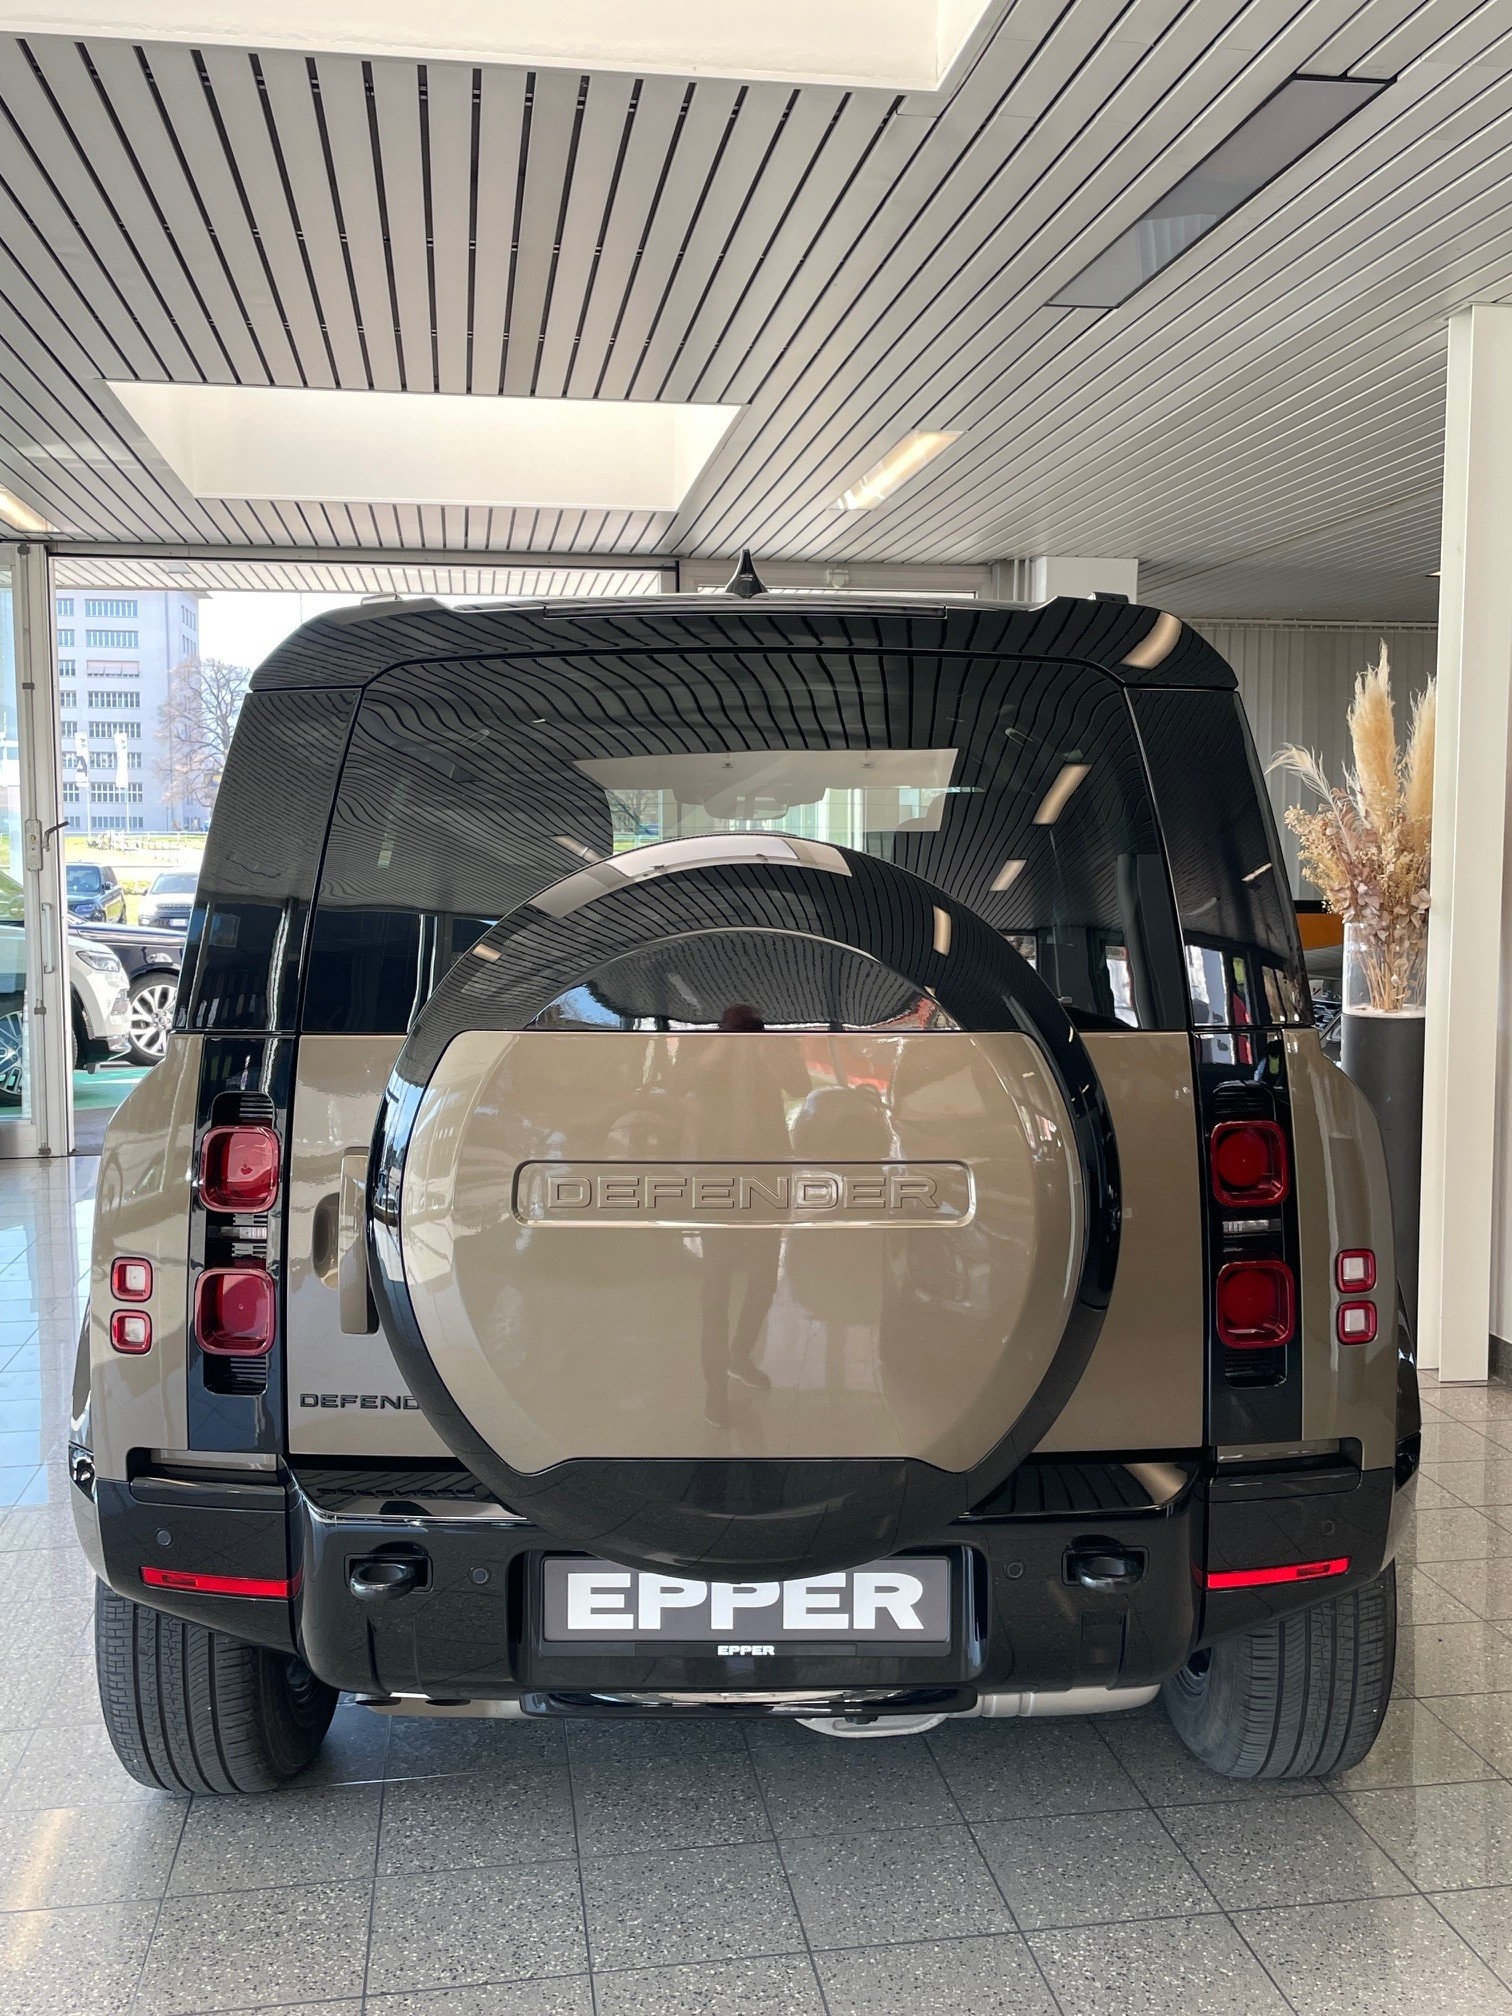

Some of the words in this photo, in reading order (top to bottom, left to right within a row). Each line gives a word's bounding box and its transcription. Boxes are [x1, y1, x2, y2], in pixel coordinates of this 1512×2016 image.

[548, 1175, 939, 1209] DEFENDER
[567, 1572, 925, 1630] EPPER
[717, 1645, 776, 1656] EPPER
